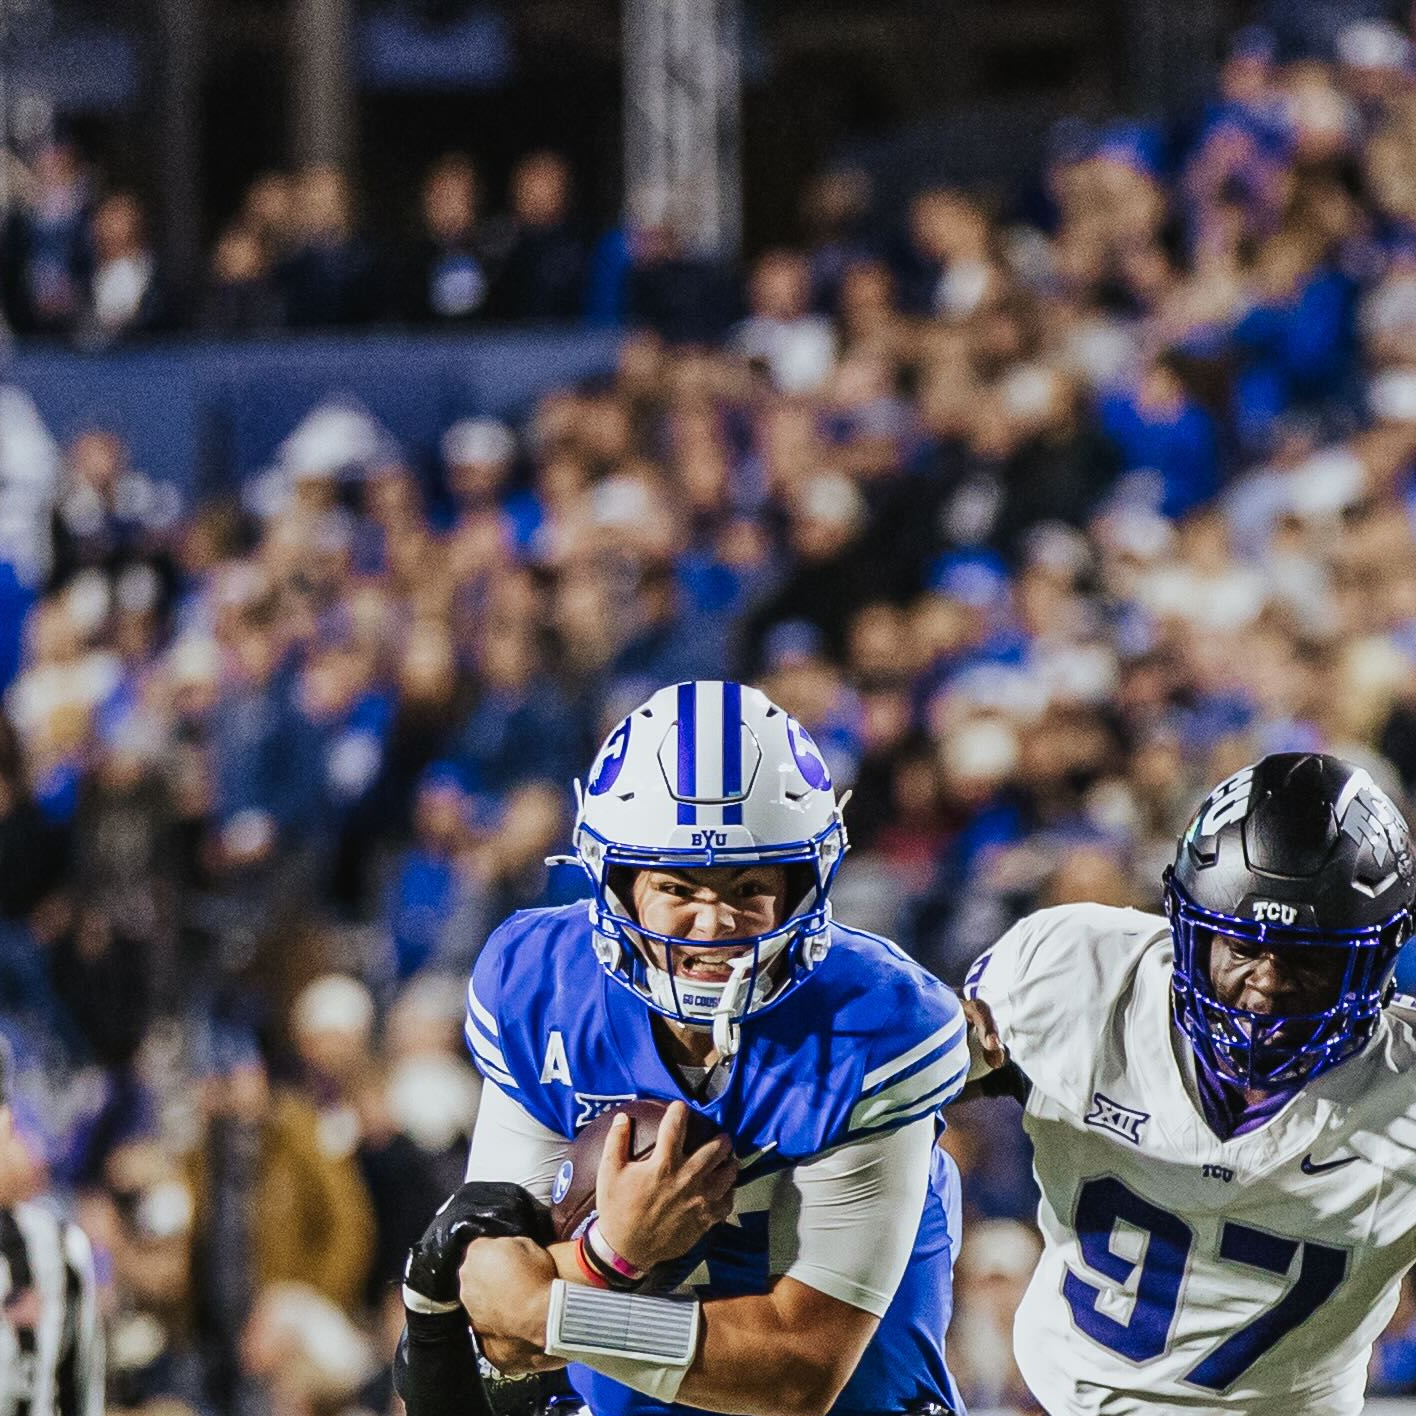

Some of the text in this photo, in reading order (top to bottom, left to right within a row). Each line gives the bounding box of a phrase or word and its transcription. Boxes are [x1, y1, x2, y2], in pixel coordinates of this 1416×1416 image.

[691, 829, 728, 849] BYU
[1253, 901, 1297, 925] TCU
[683, 994, 694, 1005] GO
[539, 1030, 574, 1087] A
[1091, 1096, 1144, 1141] XII
[1202, 1163, 1234, 1184] TCU
[1059, 1170, 1354, 1396] 97
